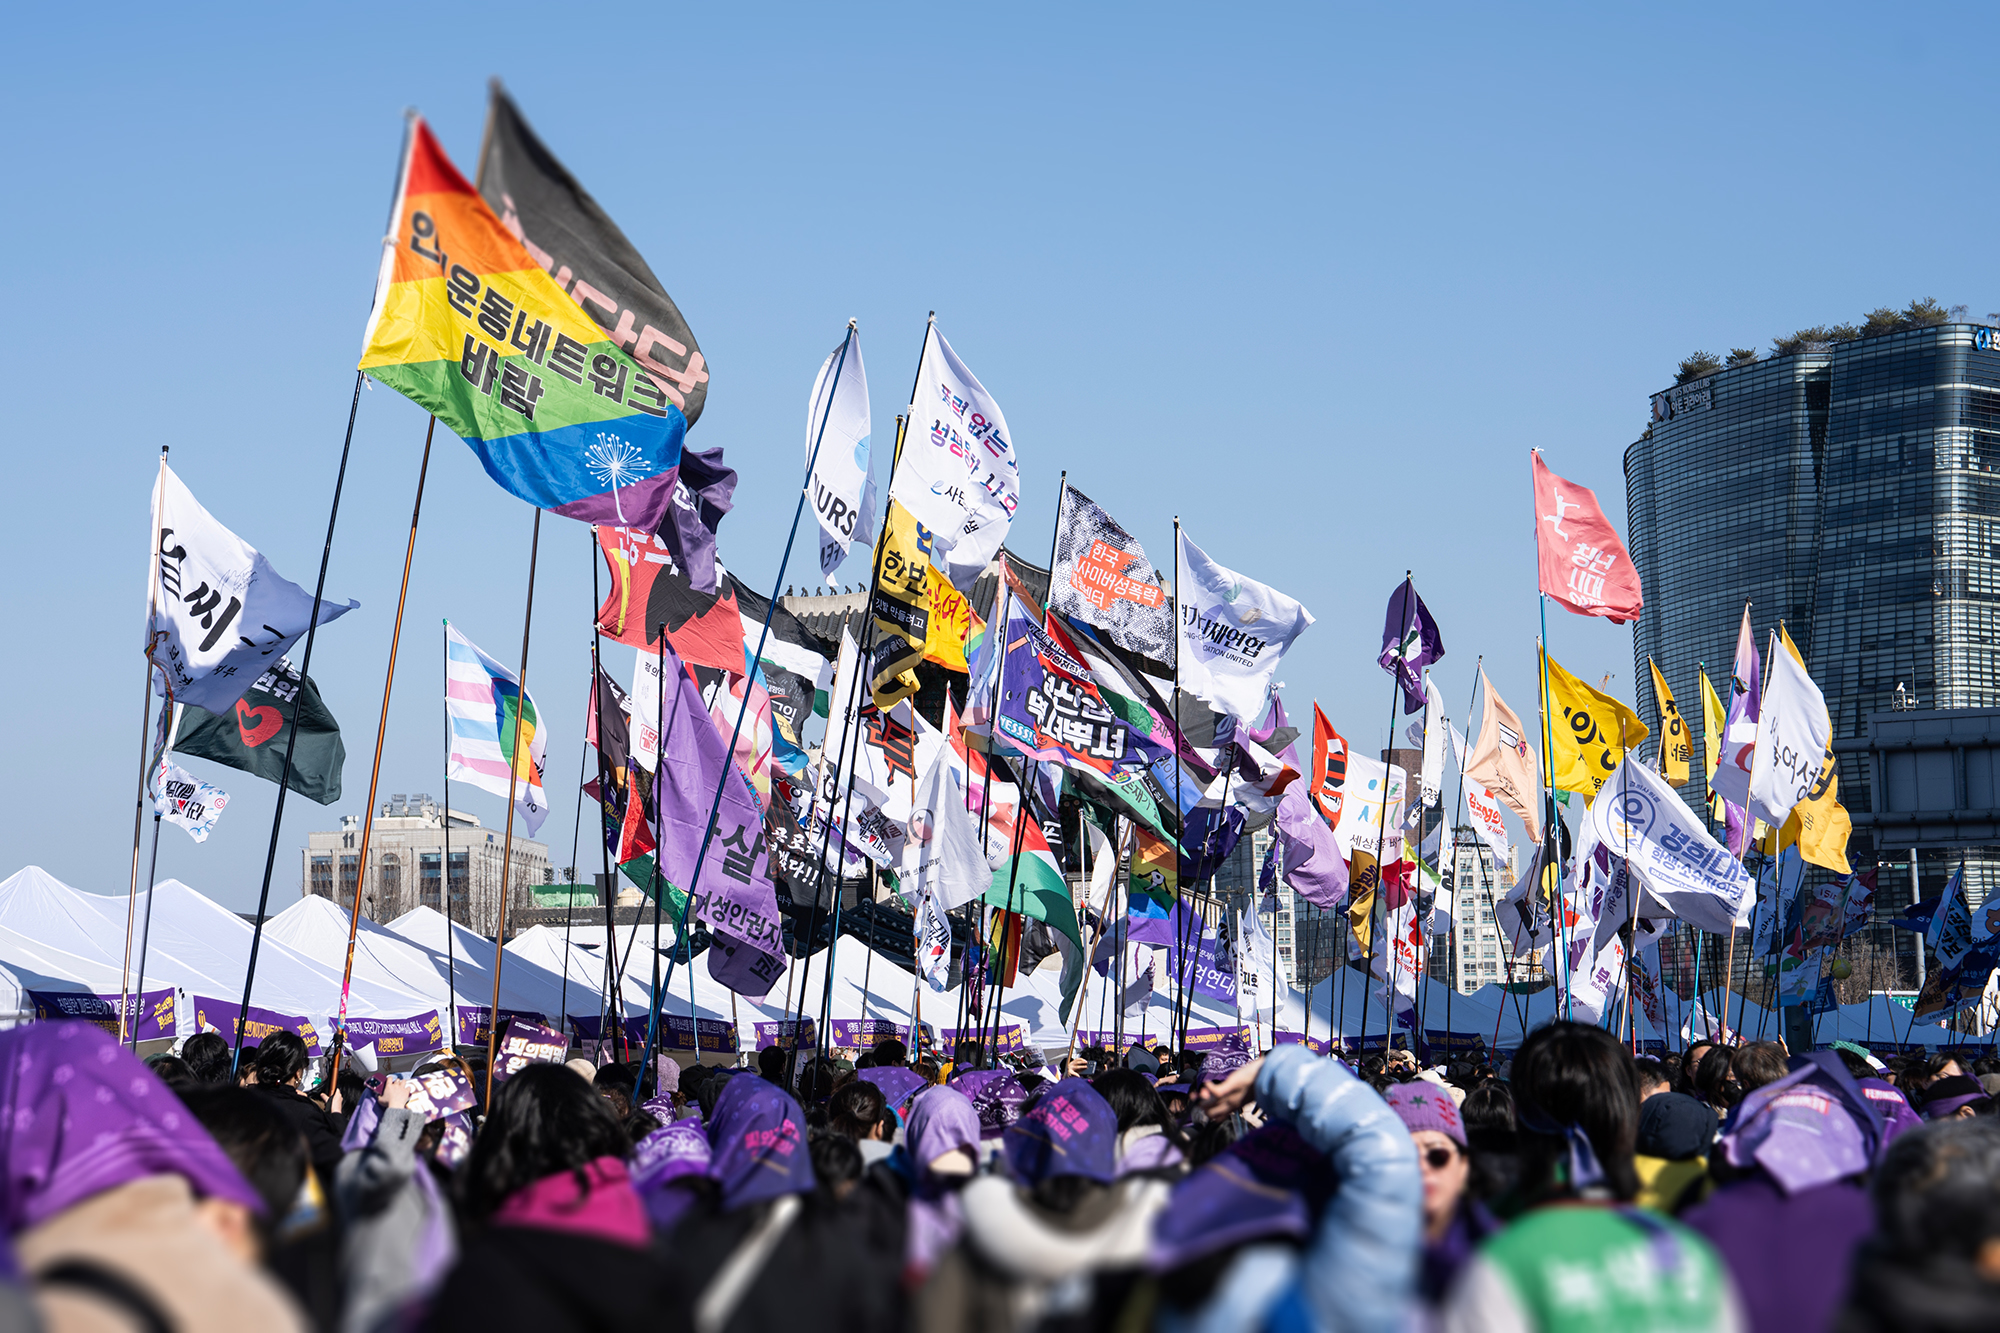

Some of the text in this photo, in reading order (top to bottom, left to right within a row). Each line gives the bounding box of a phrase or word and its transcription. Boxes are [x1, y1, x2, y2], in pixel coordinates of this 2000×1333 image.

[460, 333, 546, 421] 바람
[1682, 380, 1700, 394] KOREA
[1699, 377, 1711, 389] LAB
[969, 412, 1009, 458] 없는
[1091, 543, 1120, 567] 한국
[1572, 541, 1617, 576] 청년
[1077, 558, 1159, 604] 사이버성폭력
[1567, 567, 1605, 600] 시대
[889, 606, 925, 630] 만들려고
[1225, 652, 1254, 668] UNITED
[999, 717, 1039, 745] YESSS!
